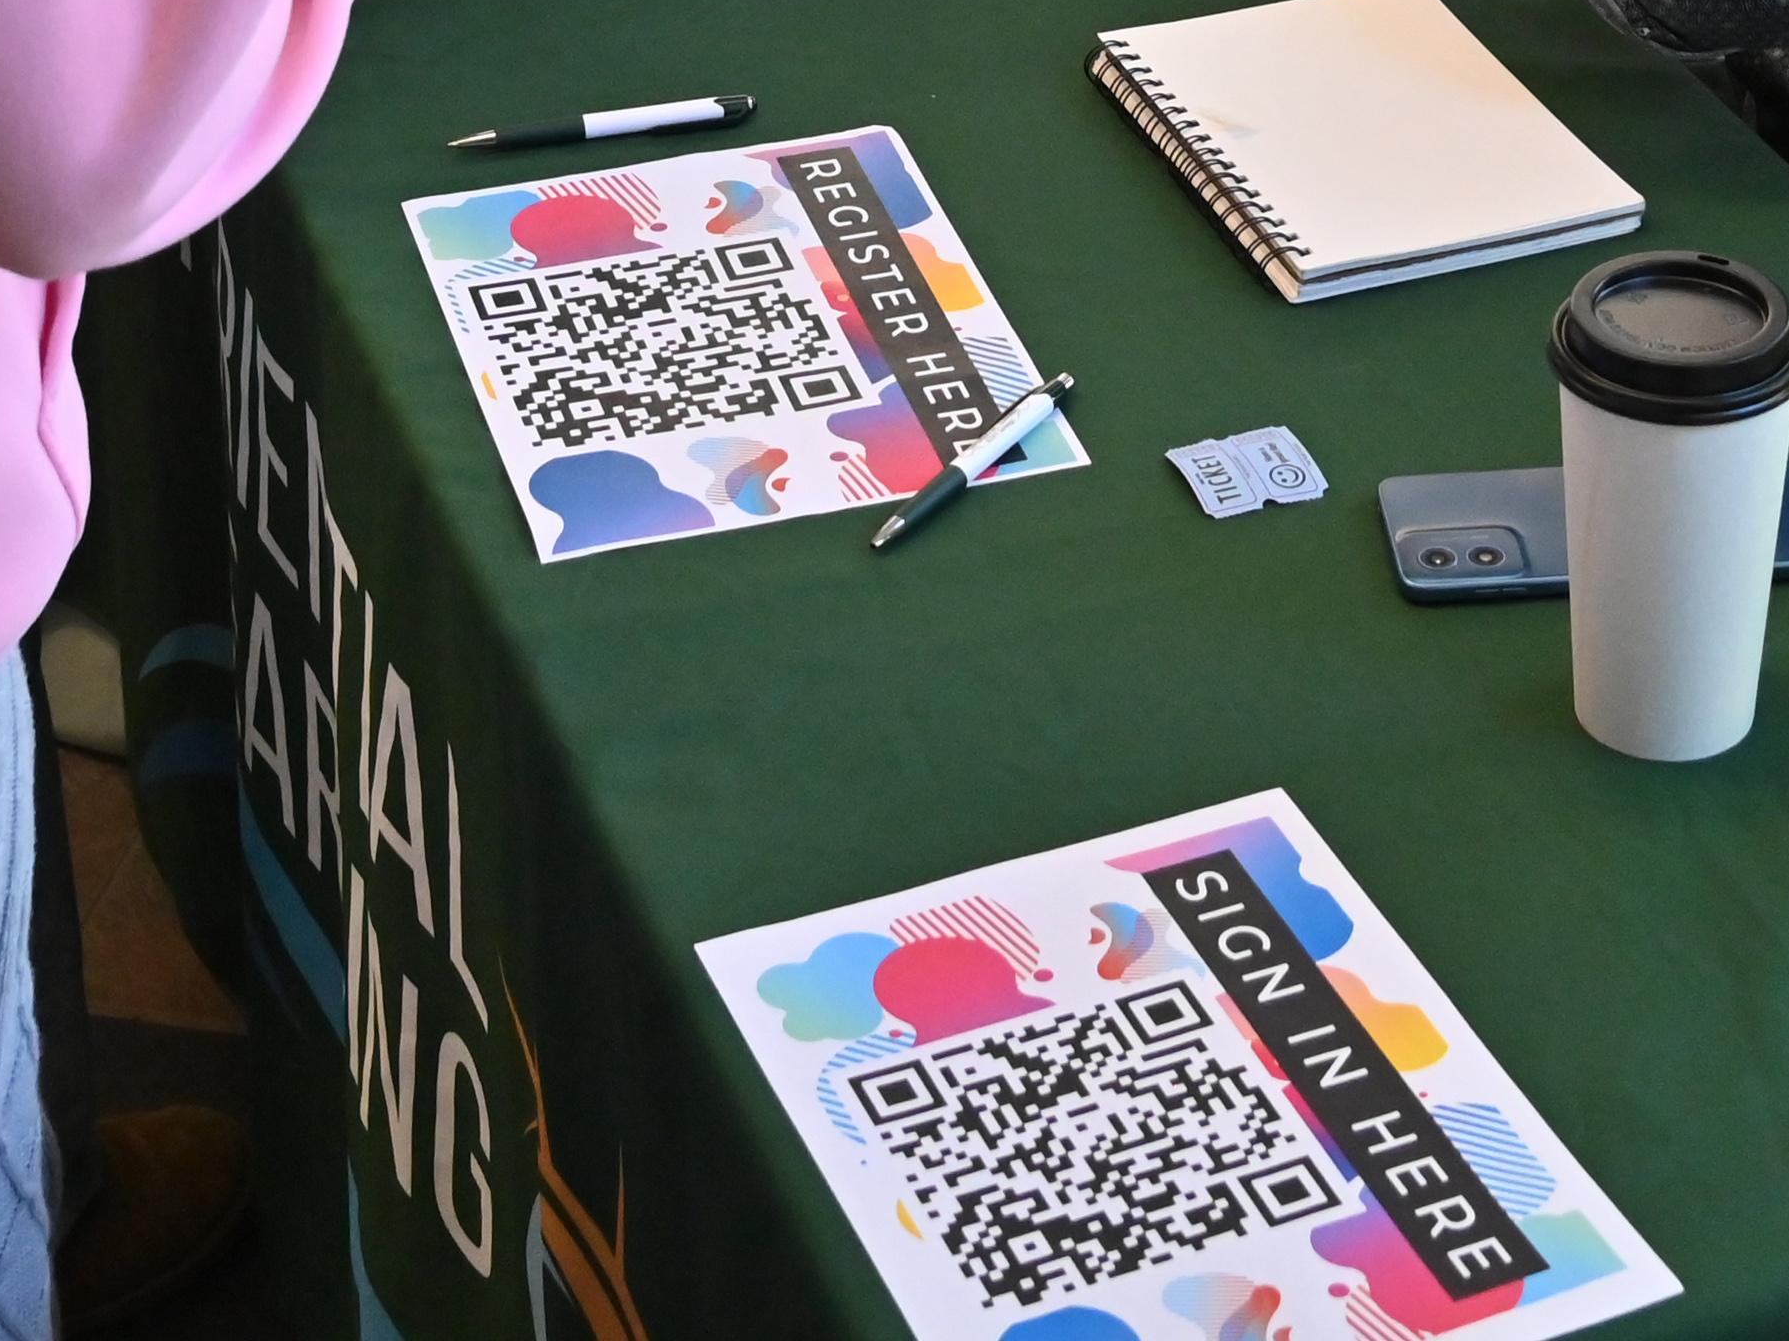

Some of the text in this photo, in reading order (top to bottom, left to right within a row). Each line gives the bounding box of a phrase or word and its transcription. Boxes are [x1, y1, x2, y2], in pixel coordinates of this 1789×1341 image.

[799, 158, 929, 338] REGISTER
[1190, 454, 1243, 505] TICKET
[1174, 869, 1513, 1280] SIGN IN HERE
